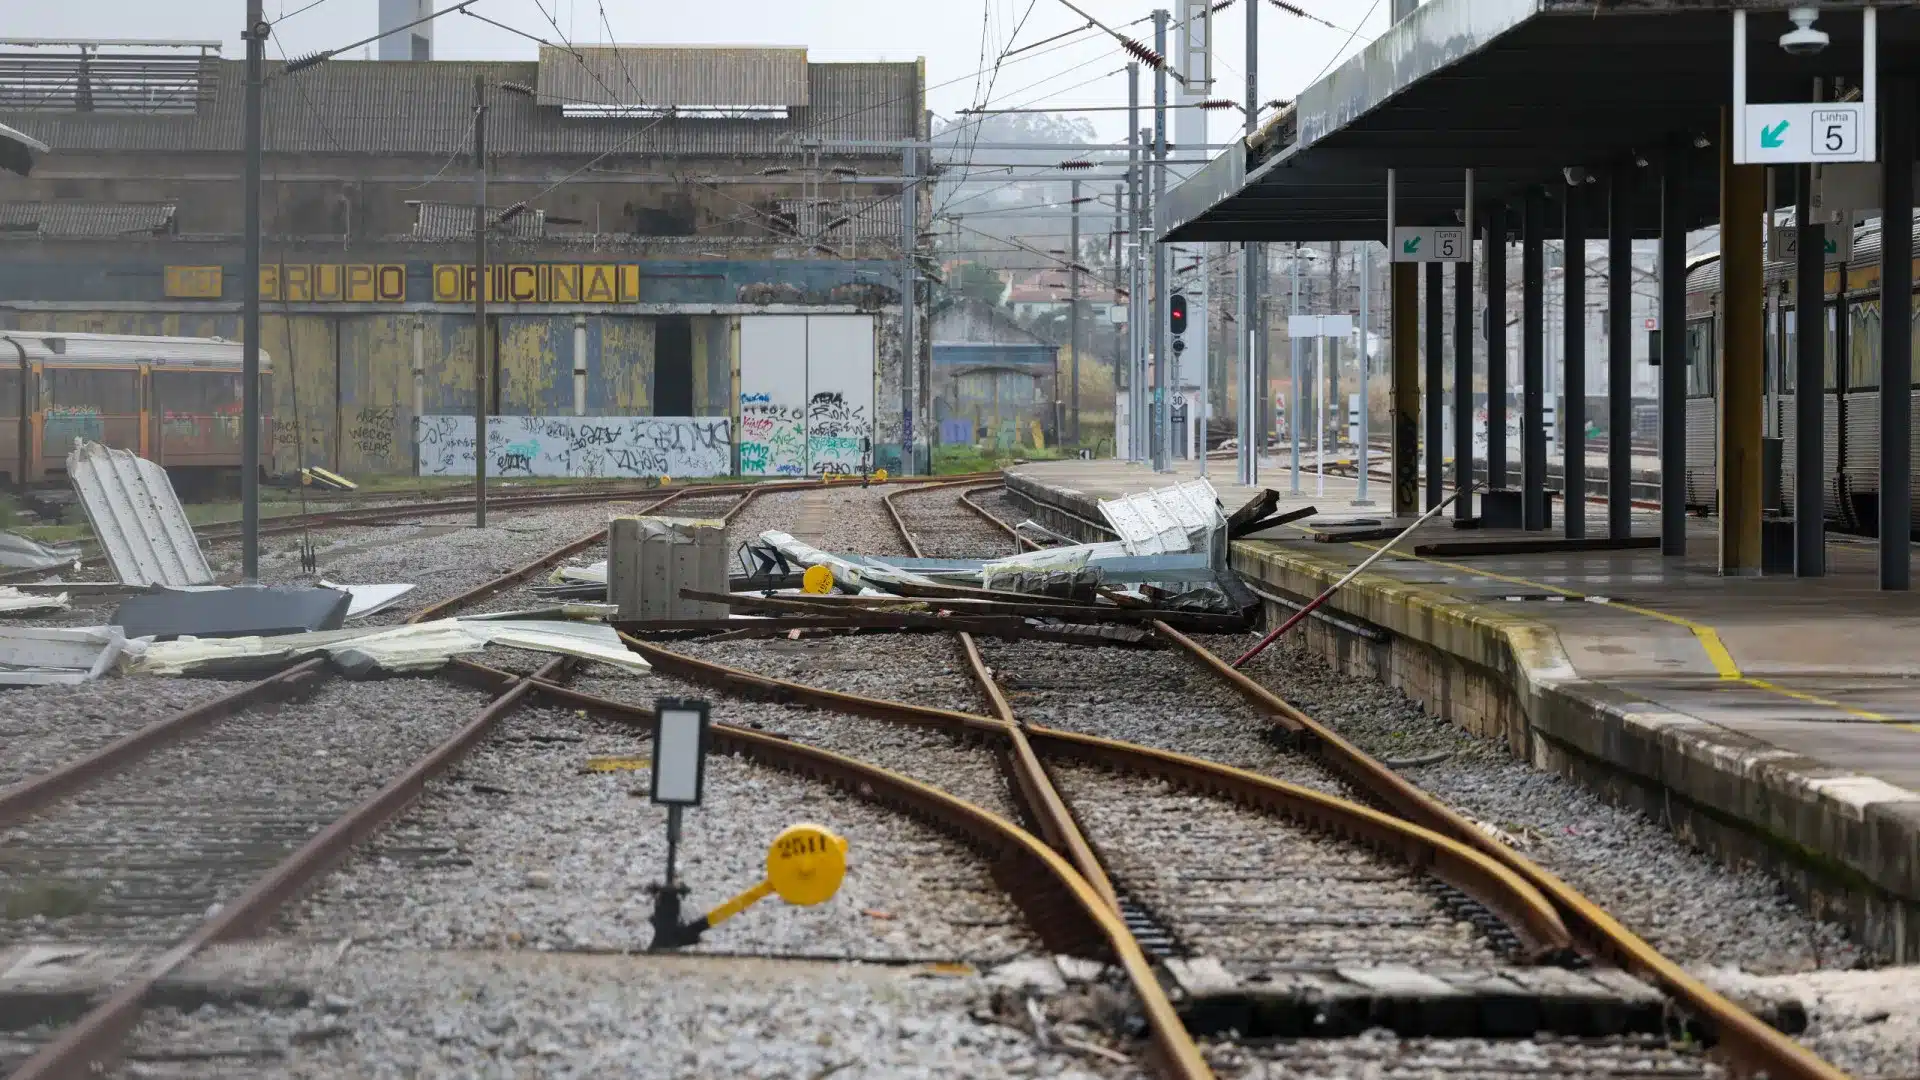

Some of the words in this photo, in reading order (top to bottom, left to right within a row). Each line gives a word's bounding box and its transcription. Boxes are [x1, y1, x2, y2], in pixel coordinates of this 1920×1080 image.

[1820, 111, 1848, 122] Linha
[1825, 125, 1843, 151] 5
[1442, 239, 1454, 256] 5
[1786, 239, 1797, 256] 4
[434, 265, 640, 301] OFICINAL
[1172, 395, 1183, 406] 30
